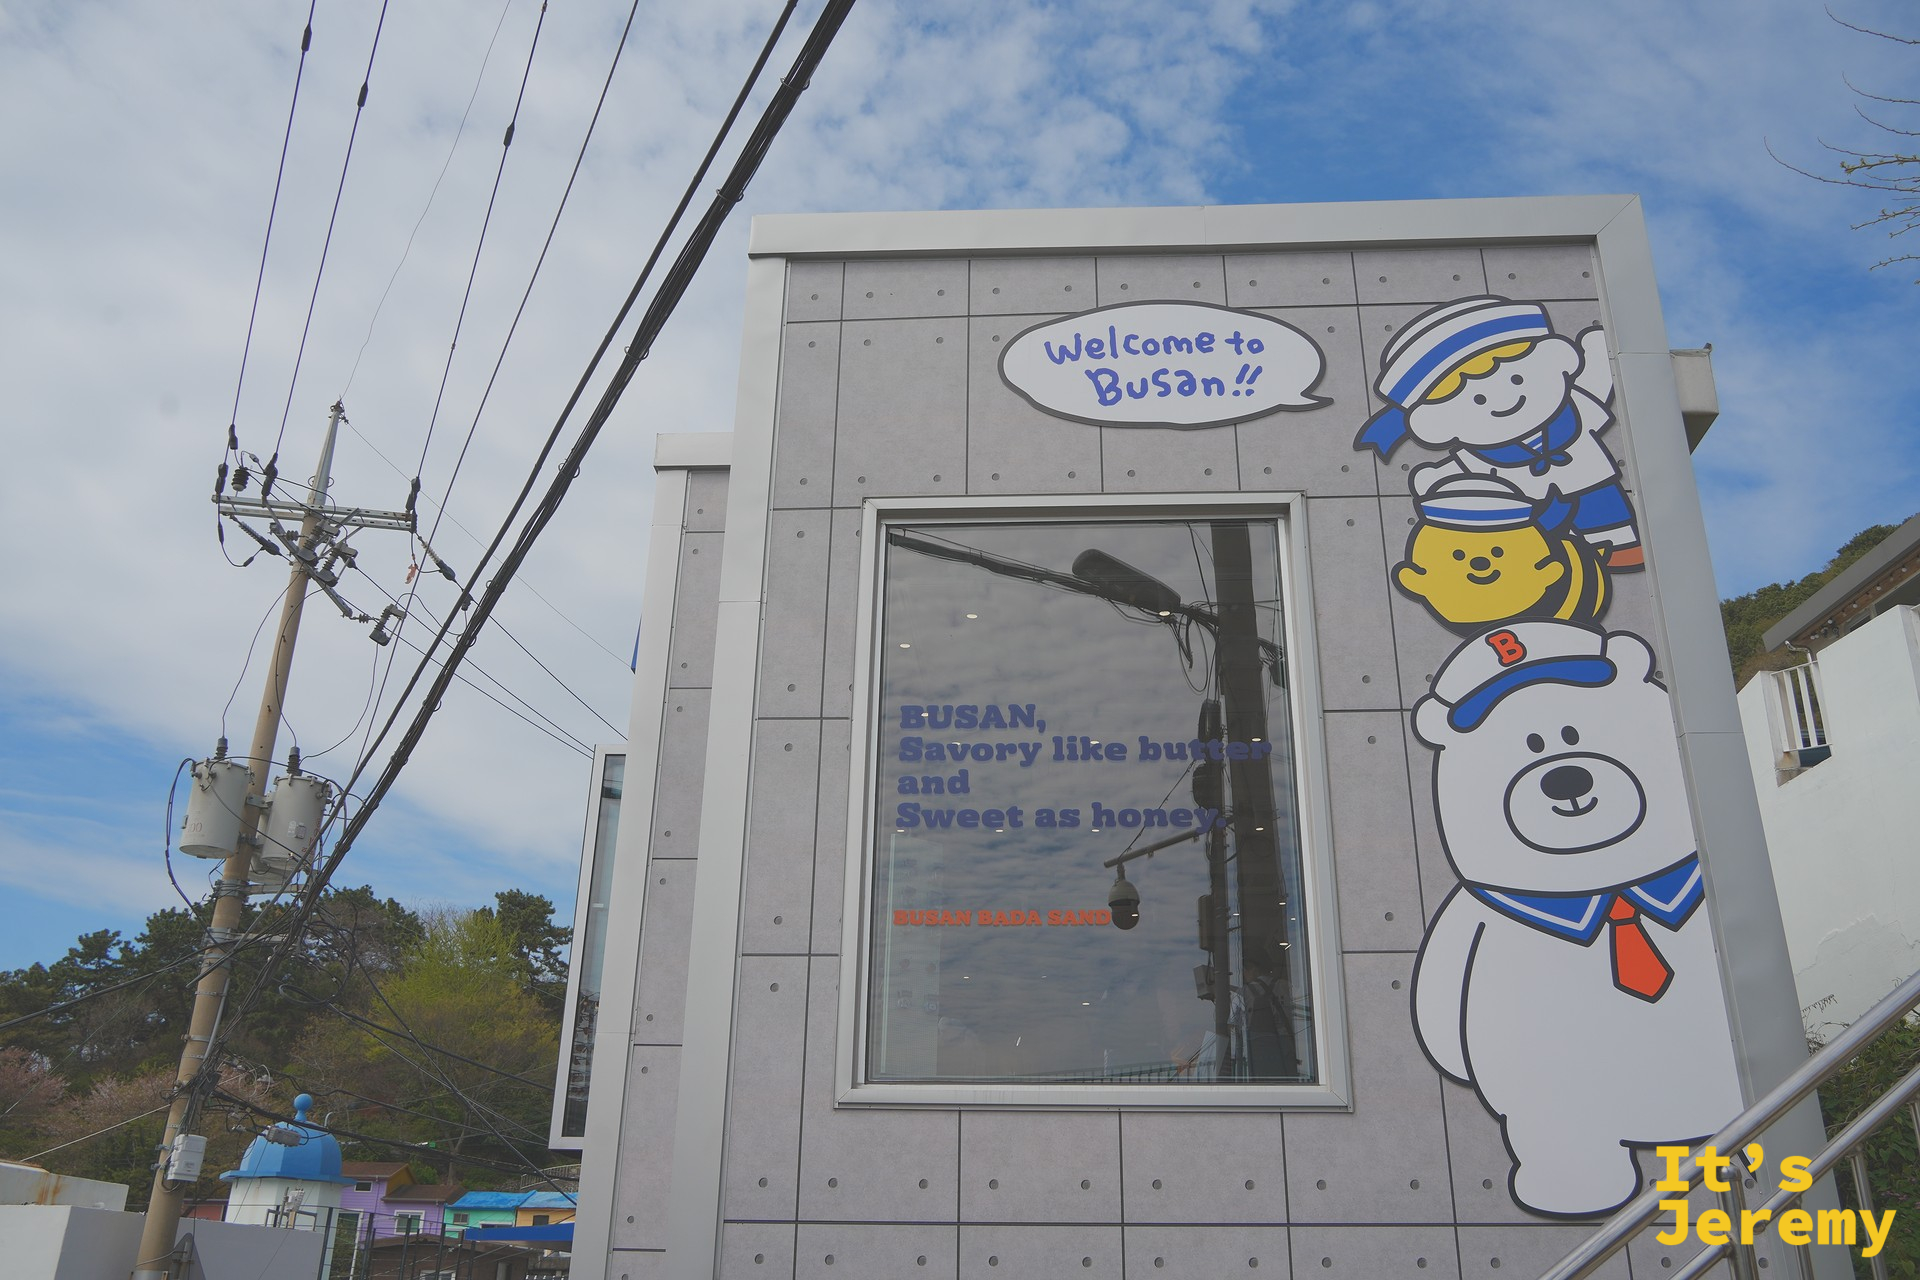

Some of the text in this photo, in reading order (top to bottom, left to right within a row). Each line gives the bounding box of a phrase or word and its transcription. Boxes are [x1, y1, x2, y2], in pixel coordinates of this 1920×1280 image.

[1044, 325, 1265, 365] Welcome to
[1486, 630, 1527, 667] B
[899, 703, 1046, 733] BUSAN,
[898, 735, 1272, 767] Savory like butter
[897, 769, 970, 795] and
[895, 802, 1228, 835] Sweet as honey.
[893, 909, 1112, 927] BUSAN BADA SAND
